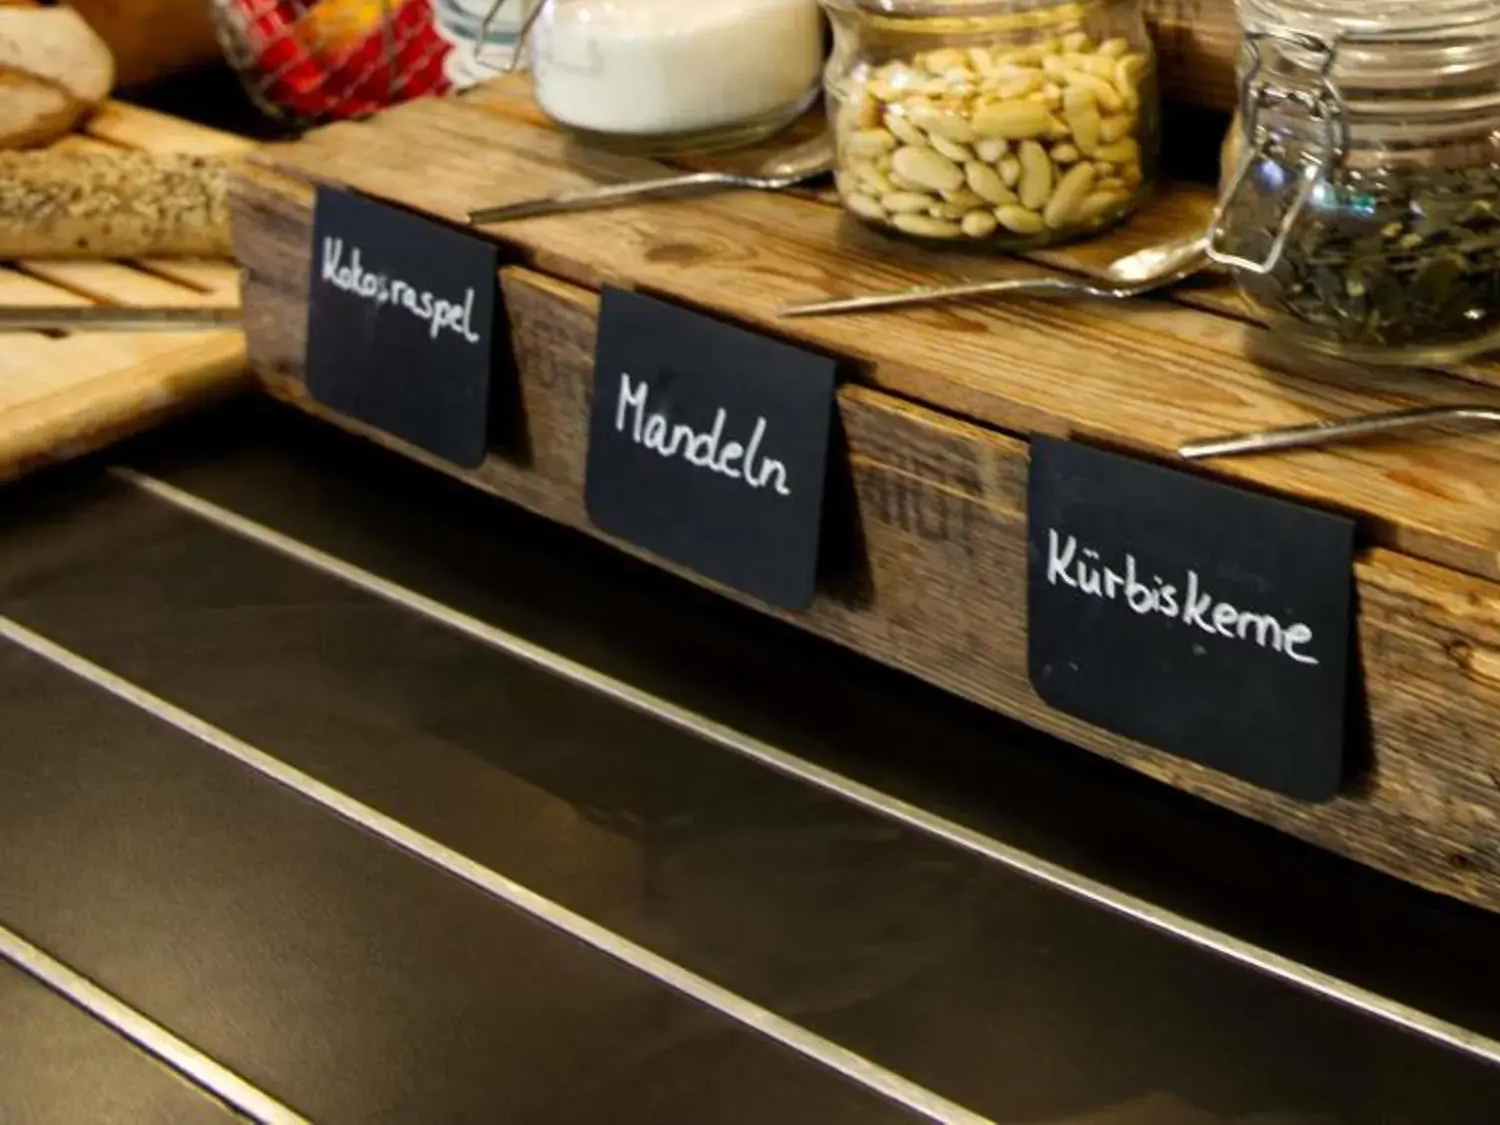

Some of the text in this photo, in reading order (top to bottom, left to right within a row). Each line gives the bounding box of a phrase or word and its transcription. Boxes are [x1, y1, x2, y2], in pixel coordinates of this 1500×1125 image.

[322, 236, 480, 343] Kokosraspel
[616, 372, 791, 495] Mandeln
[1047, 527, 1319, 664] Kürbiskerne
